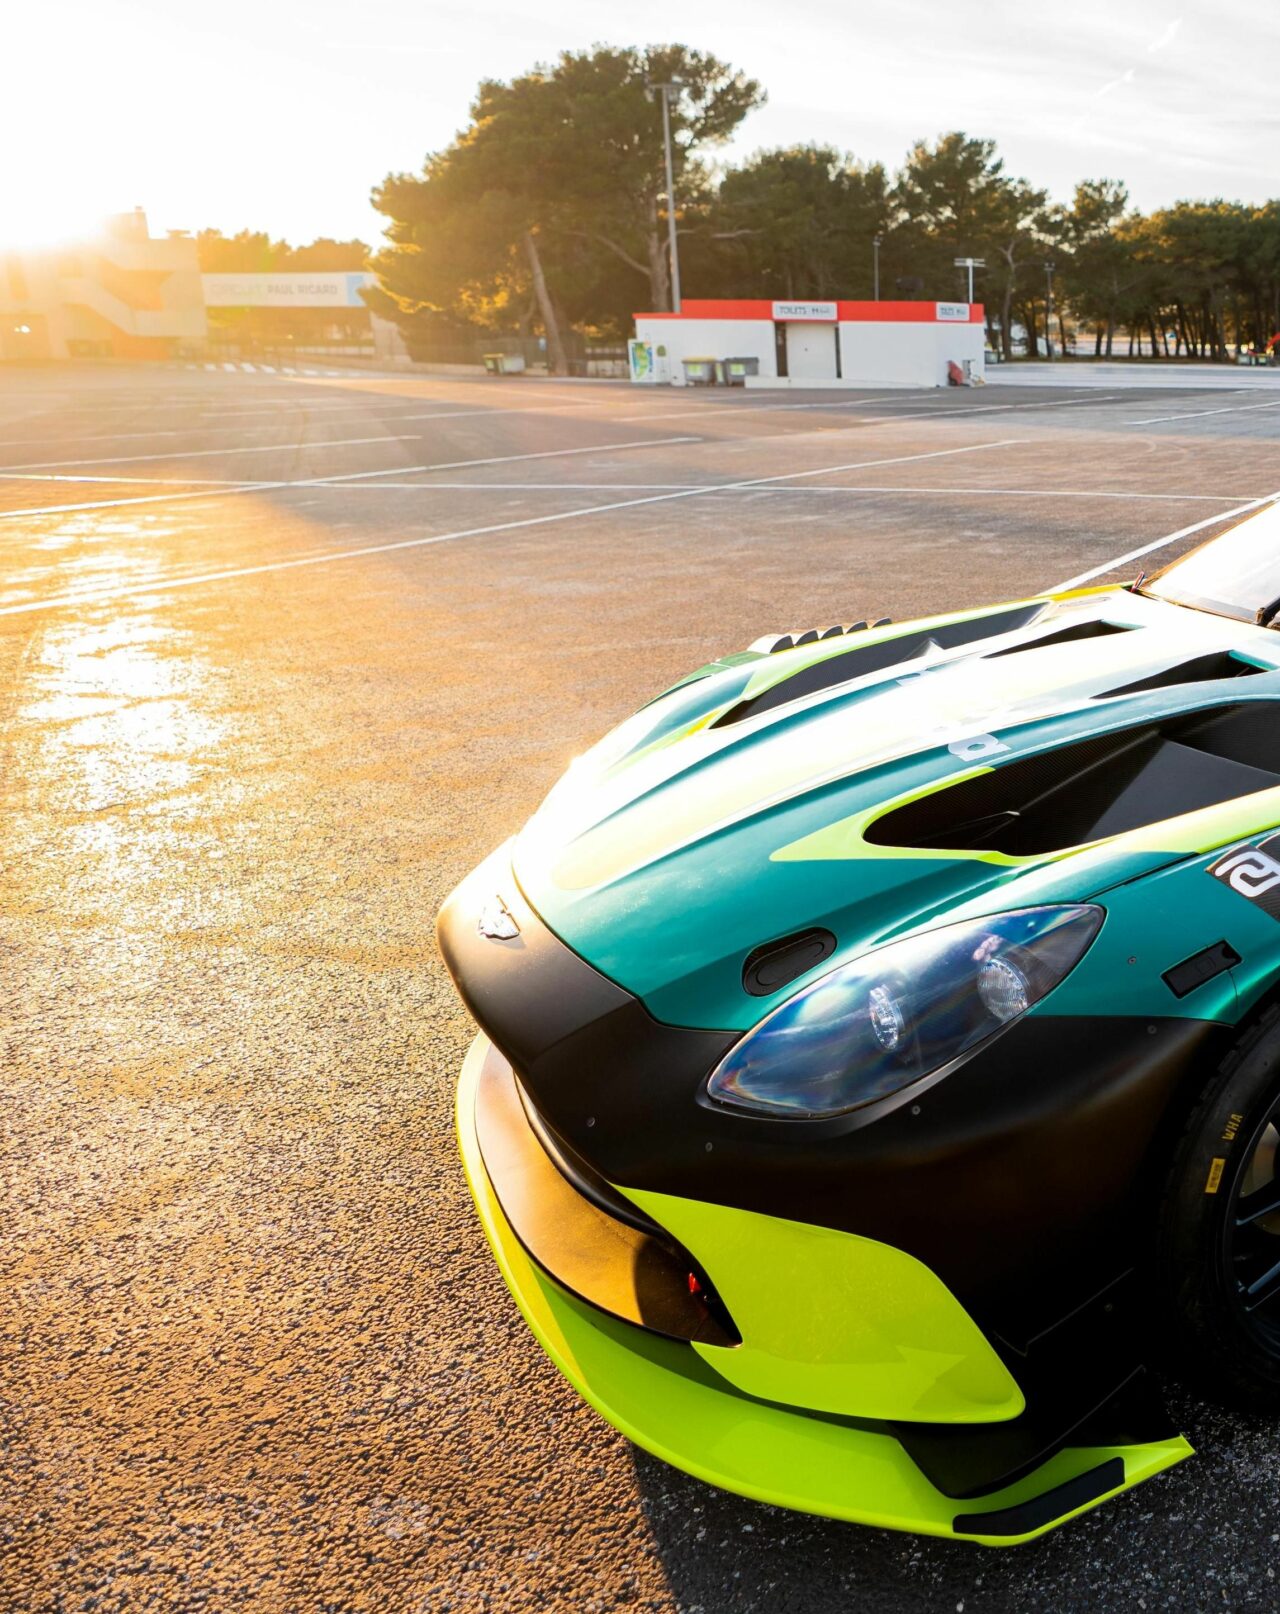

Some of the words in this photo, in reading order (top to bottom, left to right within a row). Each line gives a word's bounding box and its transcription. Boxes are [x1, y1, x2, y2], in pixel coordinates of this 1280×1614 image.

[267, 284, 295, 295] PAUL
[297, 284, 338, 295] RICARD
[1221, 1113, 1243, 1140] WHA
